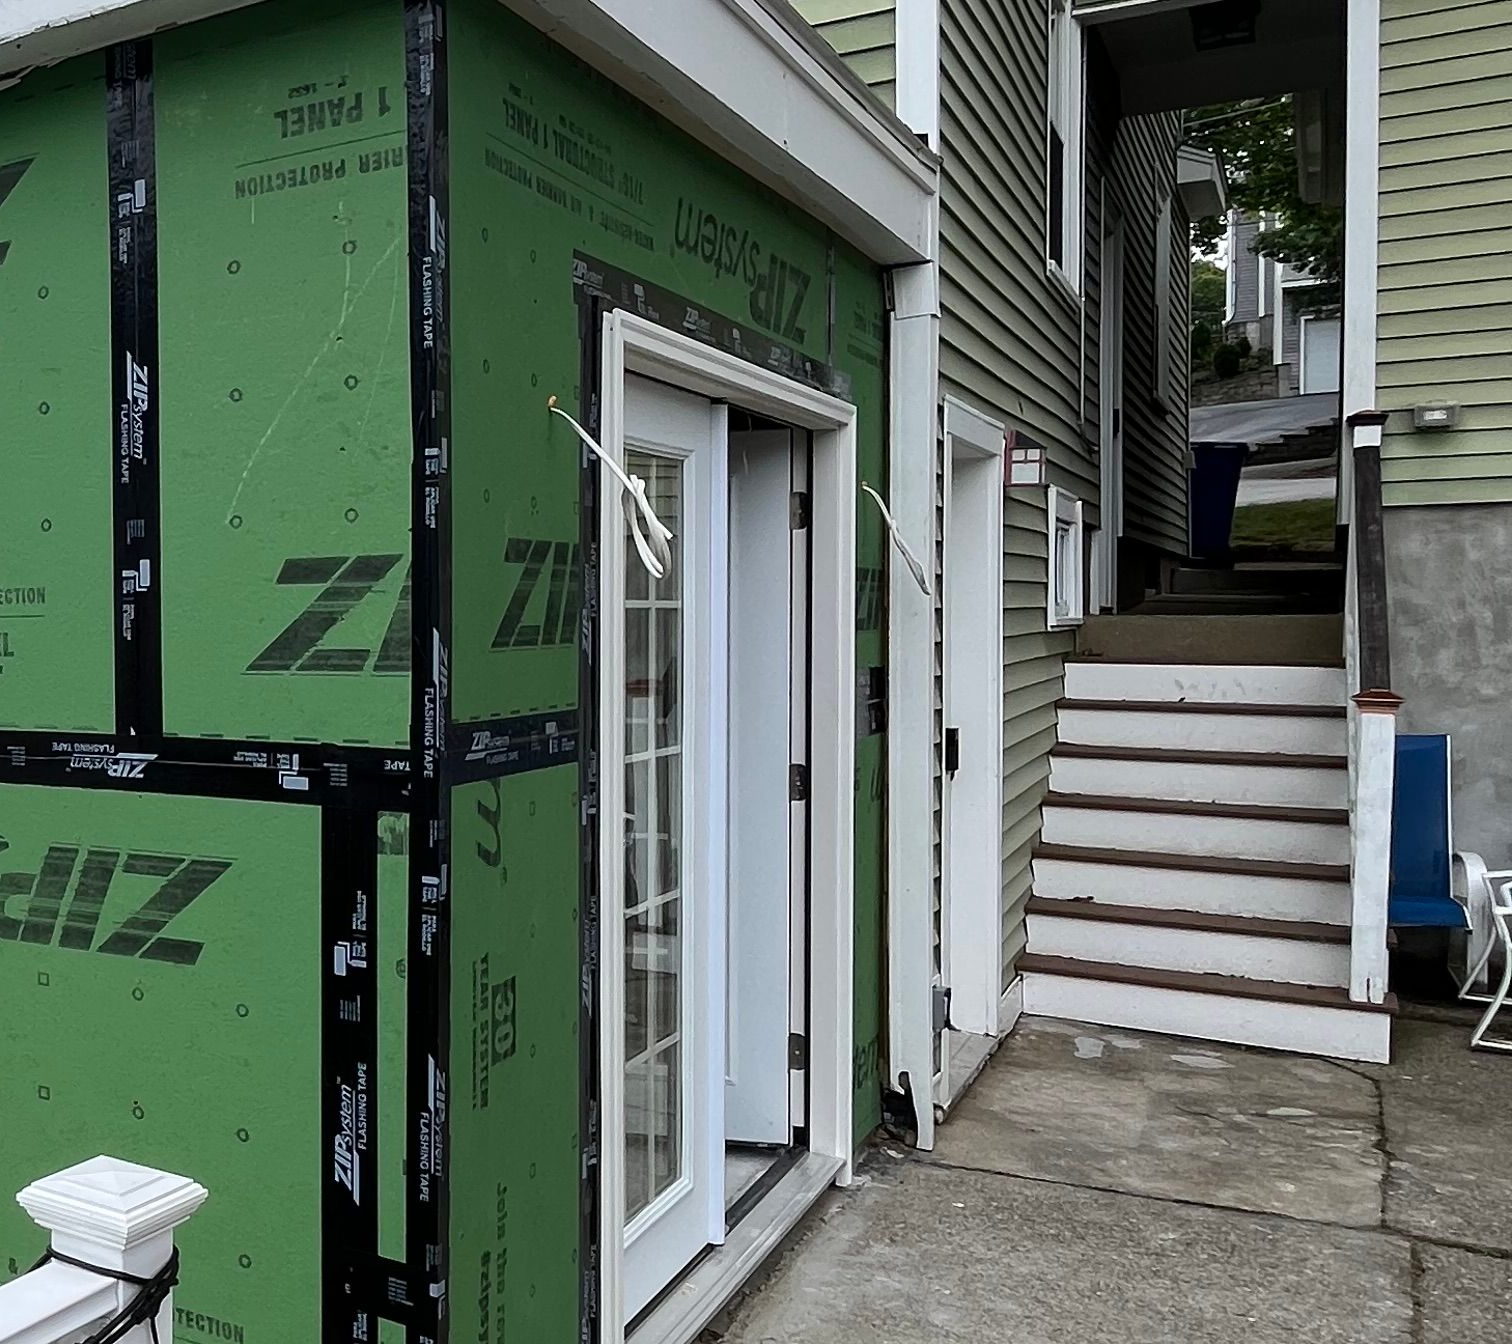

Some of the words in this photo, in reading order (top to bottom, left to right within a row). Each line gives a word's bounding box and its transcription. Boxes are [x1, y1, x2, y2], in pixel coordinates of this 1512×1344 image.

[273, 92, 364, 139] PANEL
[378, 86, 392, 117] 1
[234, 158, 346, 199] PROTECTION
[358, 147, 404, 175] RIER
[423, 257, 432, 316] FLASHING
[424, 319, 433, 349] TAPE
[121, 403, 129, 456] FLASHING
[133, 361, 148, 460] ZIPsystem
[121, 457, 129, 484] TAPE
[425, 688, 435, 746] FLASHING
[384, 759, 411, 772] TAPE
[424, 748, 434, 778] TAPE
[357, 1062, 367, 1091] TAPE
[335, 1084, 353, 1191] ZIPsystem
[358, 1094, 367, 1151] FLASHING
[420, 1112, 429, 1169] FLASHING
[420, 1173, 429, 1202] TAPE
[175, 1307, 245, 1344] TECTION
